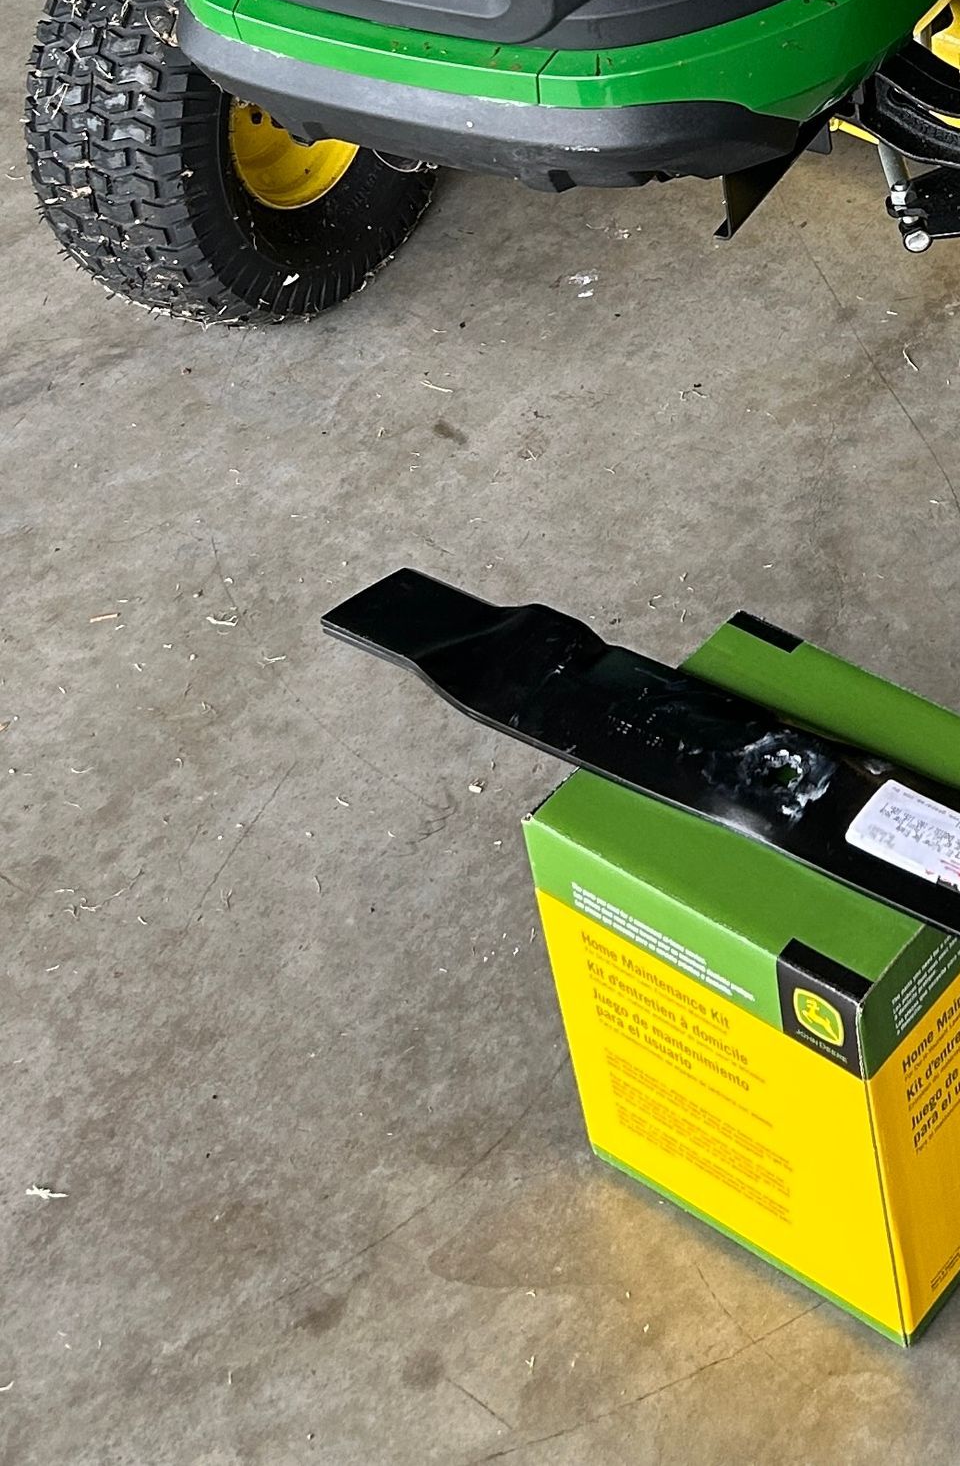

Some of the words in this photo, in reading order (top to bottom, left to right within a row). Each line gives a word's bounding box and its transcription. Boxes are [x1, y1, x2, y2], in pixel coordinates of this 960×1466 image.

[582, 930, 618, 962] Home
[621, 954, 707, 1016] Maintenance
[711, 1007, 731, 1030] Kit
[586, 960, 605, 981] Kit
[608, 974, 677, 1024] d'entretien
[679, 1015, 689, 1030] à
[692, 1023, 749, 1066] domicile
[593, 987, 629, 1019] Juego
[632, 1012, 648, 1031] de
[652, 1025, 750, 1092] mantenimiento
[595, 1005, 625, 1030] para
[628, 1023, 641, 1038] el
[644, 1034, 693, 1071] usuario
[902, 1031, 935, 1075] Home
[906, 1076, 924, 1103] Kit
[911, 1088, 943, 1131] Juego
[945, 1068, 960, 1089] de
[913, 1110, 939, 1148] para
[941, 1093, 952, 1112] el
